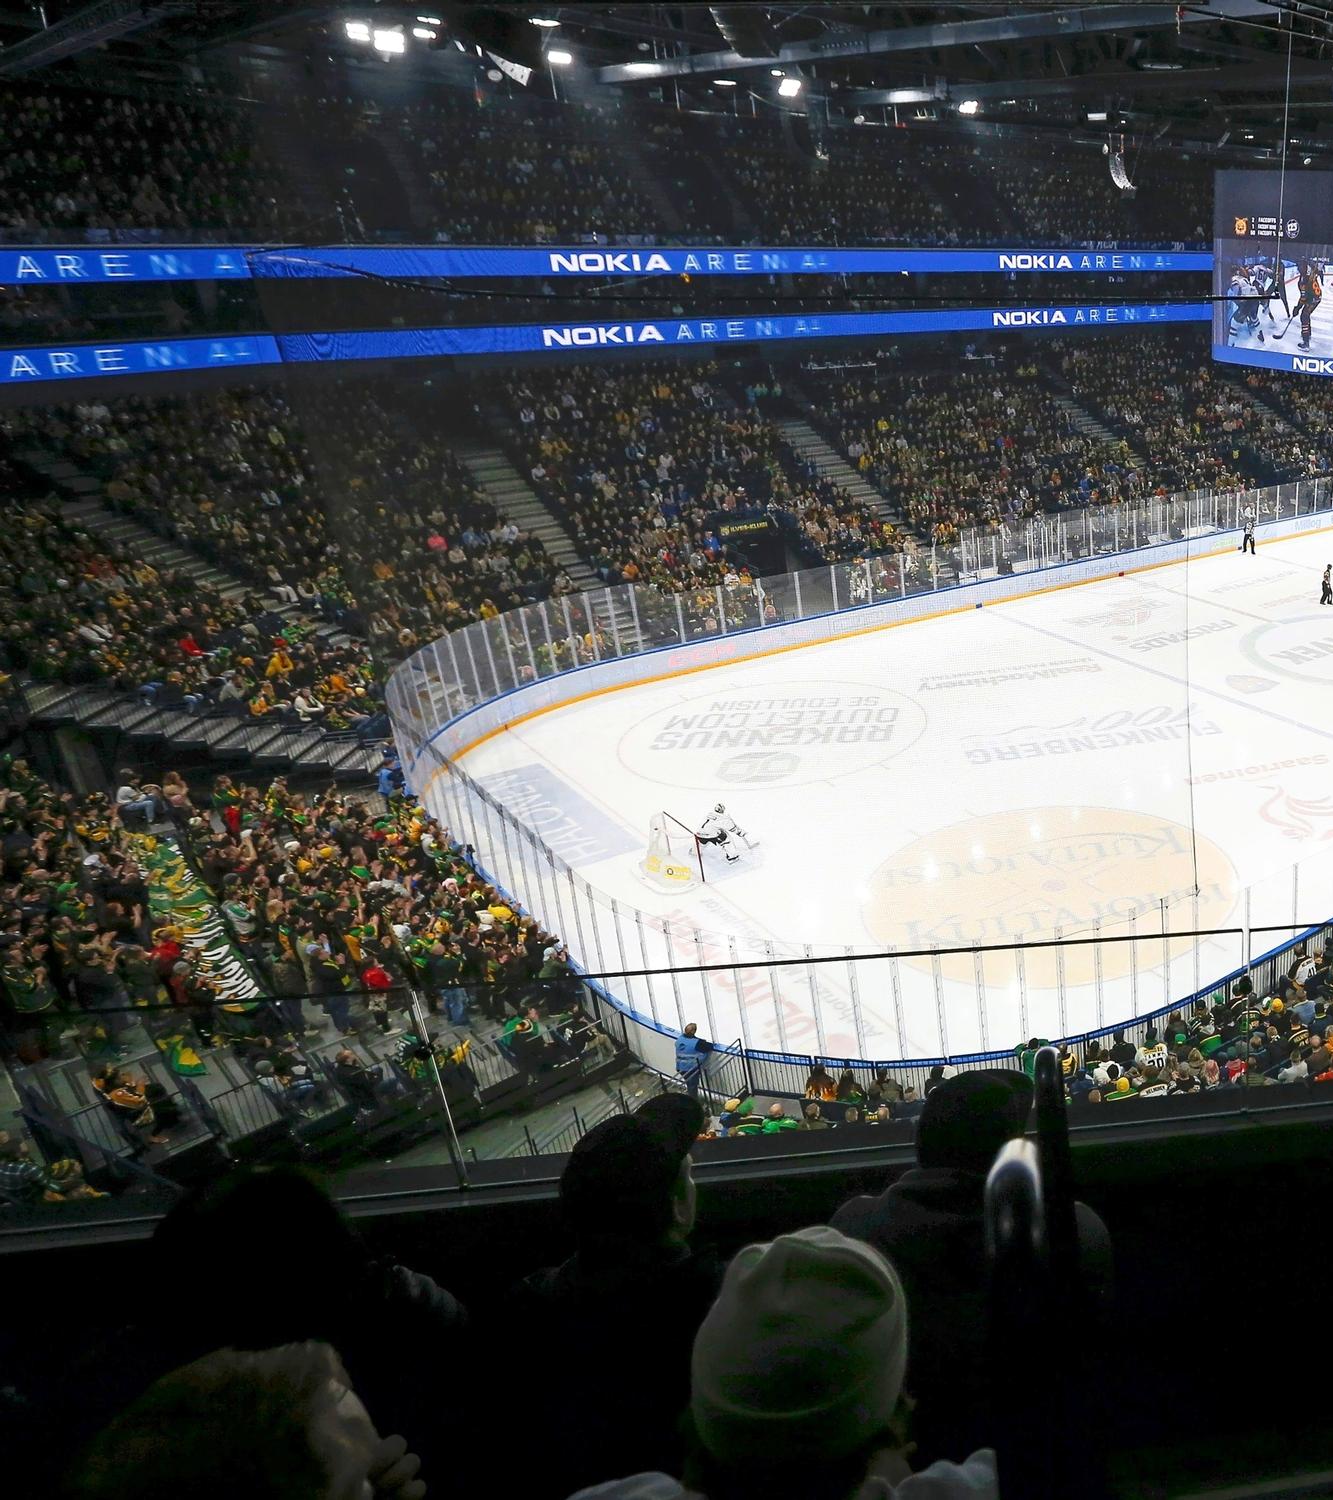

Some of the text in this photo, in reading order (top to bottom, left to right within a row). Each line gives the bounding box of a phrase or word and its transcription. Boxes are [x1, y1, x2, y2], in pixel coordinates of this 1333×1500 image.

[550, 253, 671, 272] NOKIA
[999, 254, 1072, 270] NOKIA
[993, 309, 1067, 326] NOKIA
[543, 325, 664, 346] NOKIA
[710, 696, 880, 711] SE EDULLISIN
[649, 724, 895, 750] RAKENNUS
[964, 719, 1222, 764] FLINKENBERG
